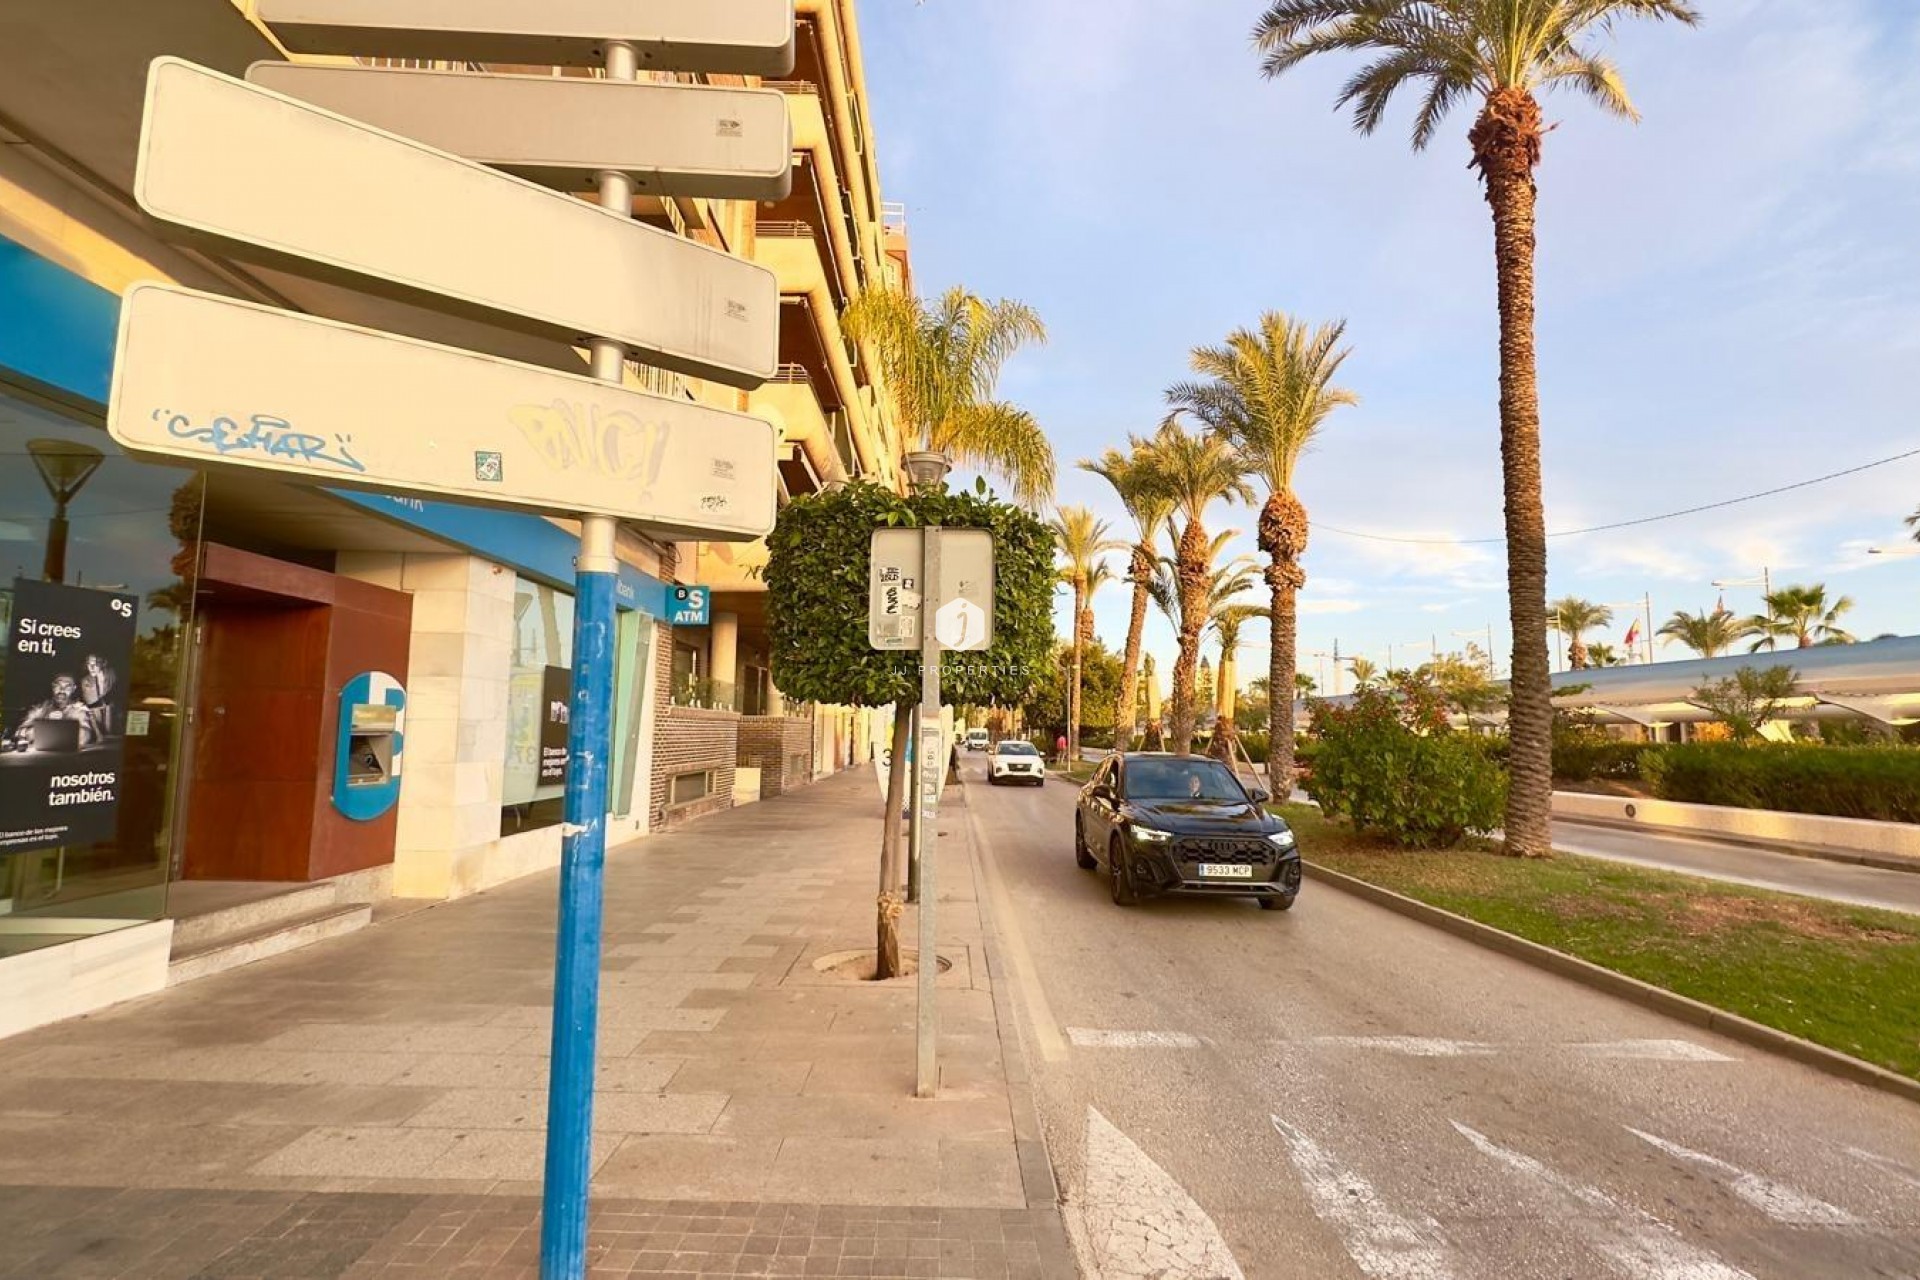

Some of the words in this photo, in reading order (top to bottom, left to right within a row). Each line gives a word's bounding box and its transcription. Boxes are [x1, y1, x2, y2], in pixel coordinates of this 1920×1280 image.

[674, 611, 703, 623] ATM
[19, 618, 36, 634] Si
[38, 623, 81, 638] crees
[18, 639, 39, 653] en
[41, 638, 56, 657] ti,
[50, 771, 116, 788] nosotros
[48, 786, 115, 806] también.
[1206, 865, 1230, 875] 9533
[1232, 865, 1250, 874] MCP
